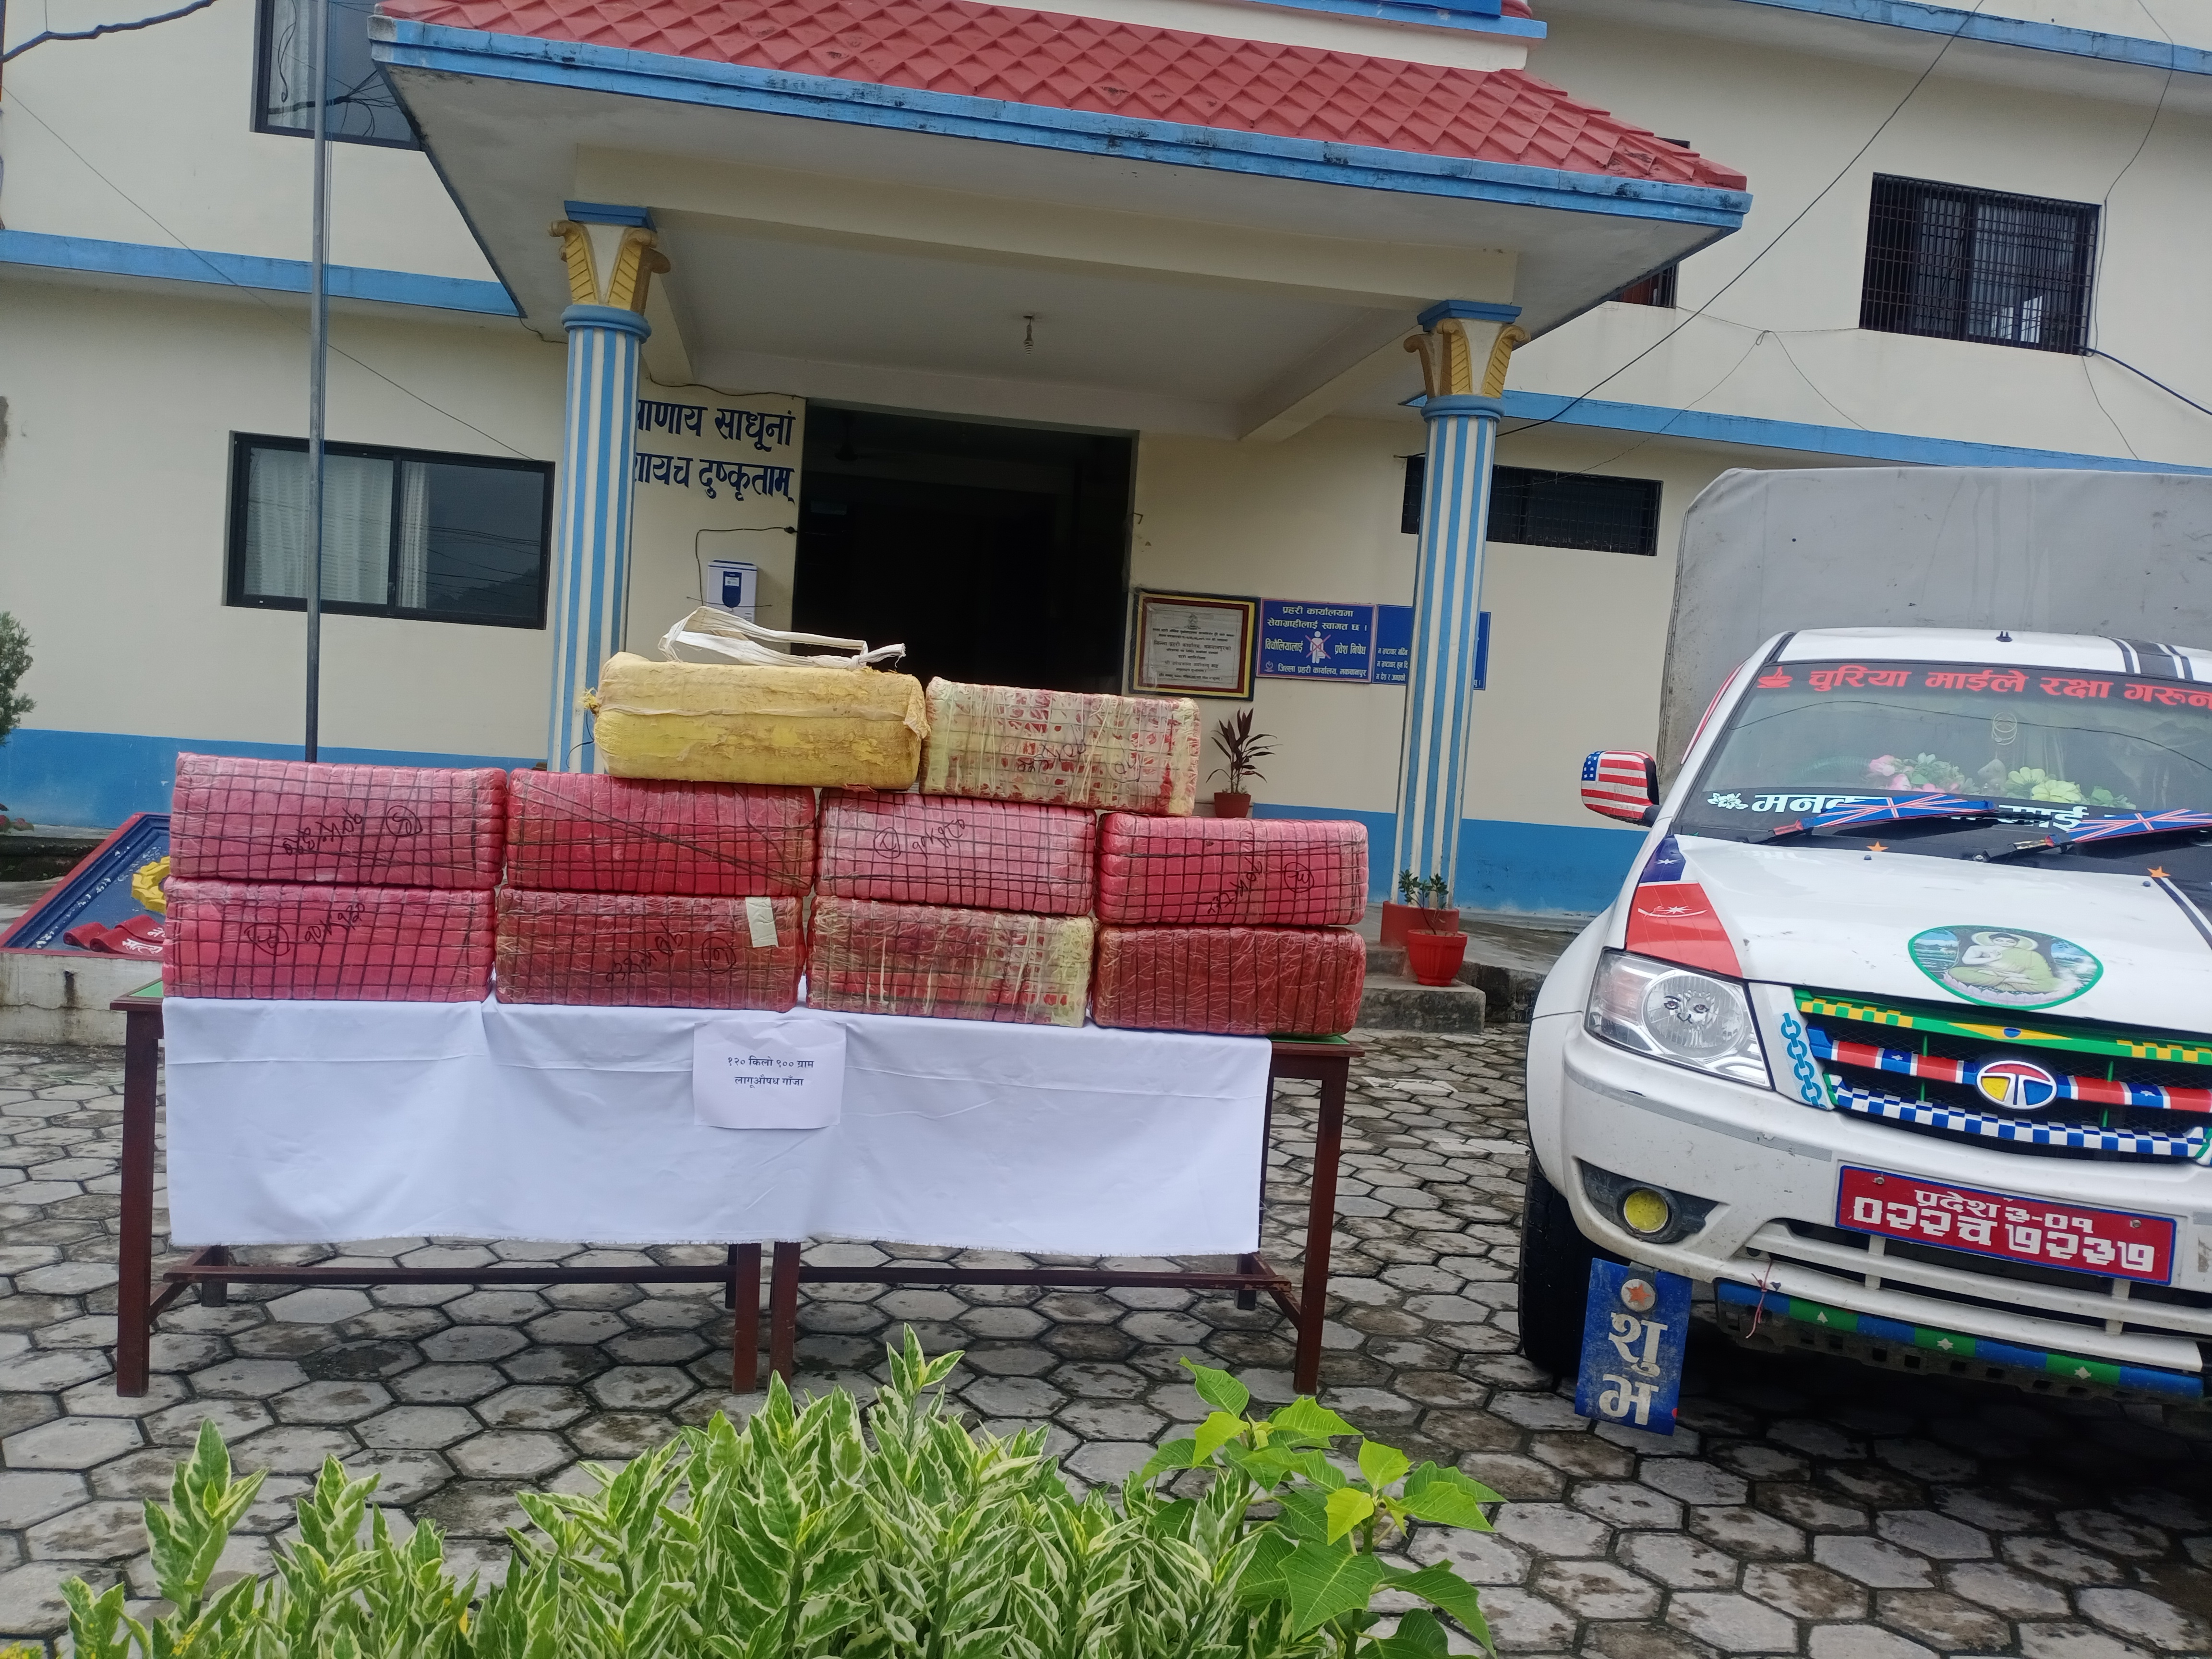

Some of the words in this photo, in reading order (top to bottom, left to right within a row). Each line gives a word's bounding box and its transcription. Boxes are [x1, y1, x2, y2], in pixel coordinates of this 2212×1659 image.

[714, 409, 796, 452] साधूनां
[699, 459, 795, 505] दुष्कृताम्
[1282, 605, 1303, 614] प्रहरी
[1307, 607, 1354, 617] कार्यालयमा
[1267, 617, 1319, 629] सेवाग्राहीलाई
[1322, 622, 1348, 630] स्वागत
[1334, 642, 1348, 655] प्रवेश
[1277, 663, 1296, 673] जिल्ला
[1298, 665, 1311, 673] प्रहरी
[1339, 668, 1367, 677] मकवानपुर
[1808, 665, 1912, 692] चुरिया
[1924, 669, 2029, 692] माईले
[2040, 677, 2115, 699] रक्षा
[728, 1057, 745, 1067] १२०
[748, 1055, 774, 1067] किलो
[776, 1059, 794, 1068] ९००
[796, 1059, 815, 1068] ग्राम
[734, 1074, 780, 1089] लागूऔषध
[781, 1075, 805, 1086] गाँजा
[1914, 1189, 2002, 1218] प्रदेश
